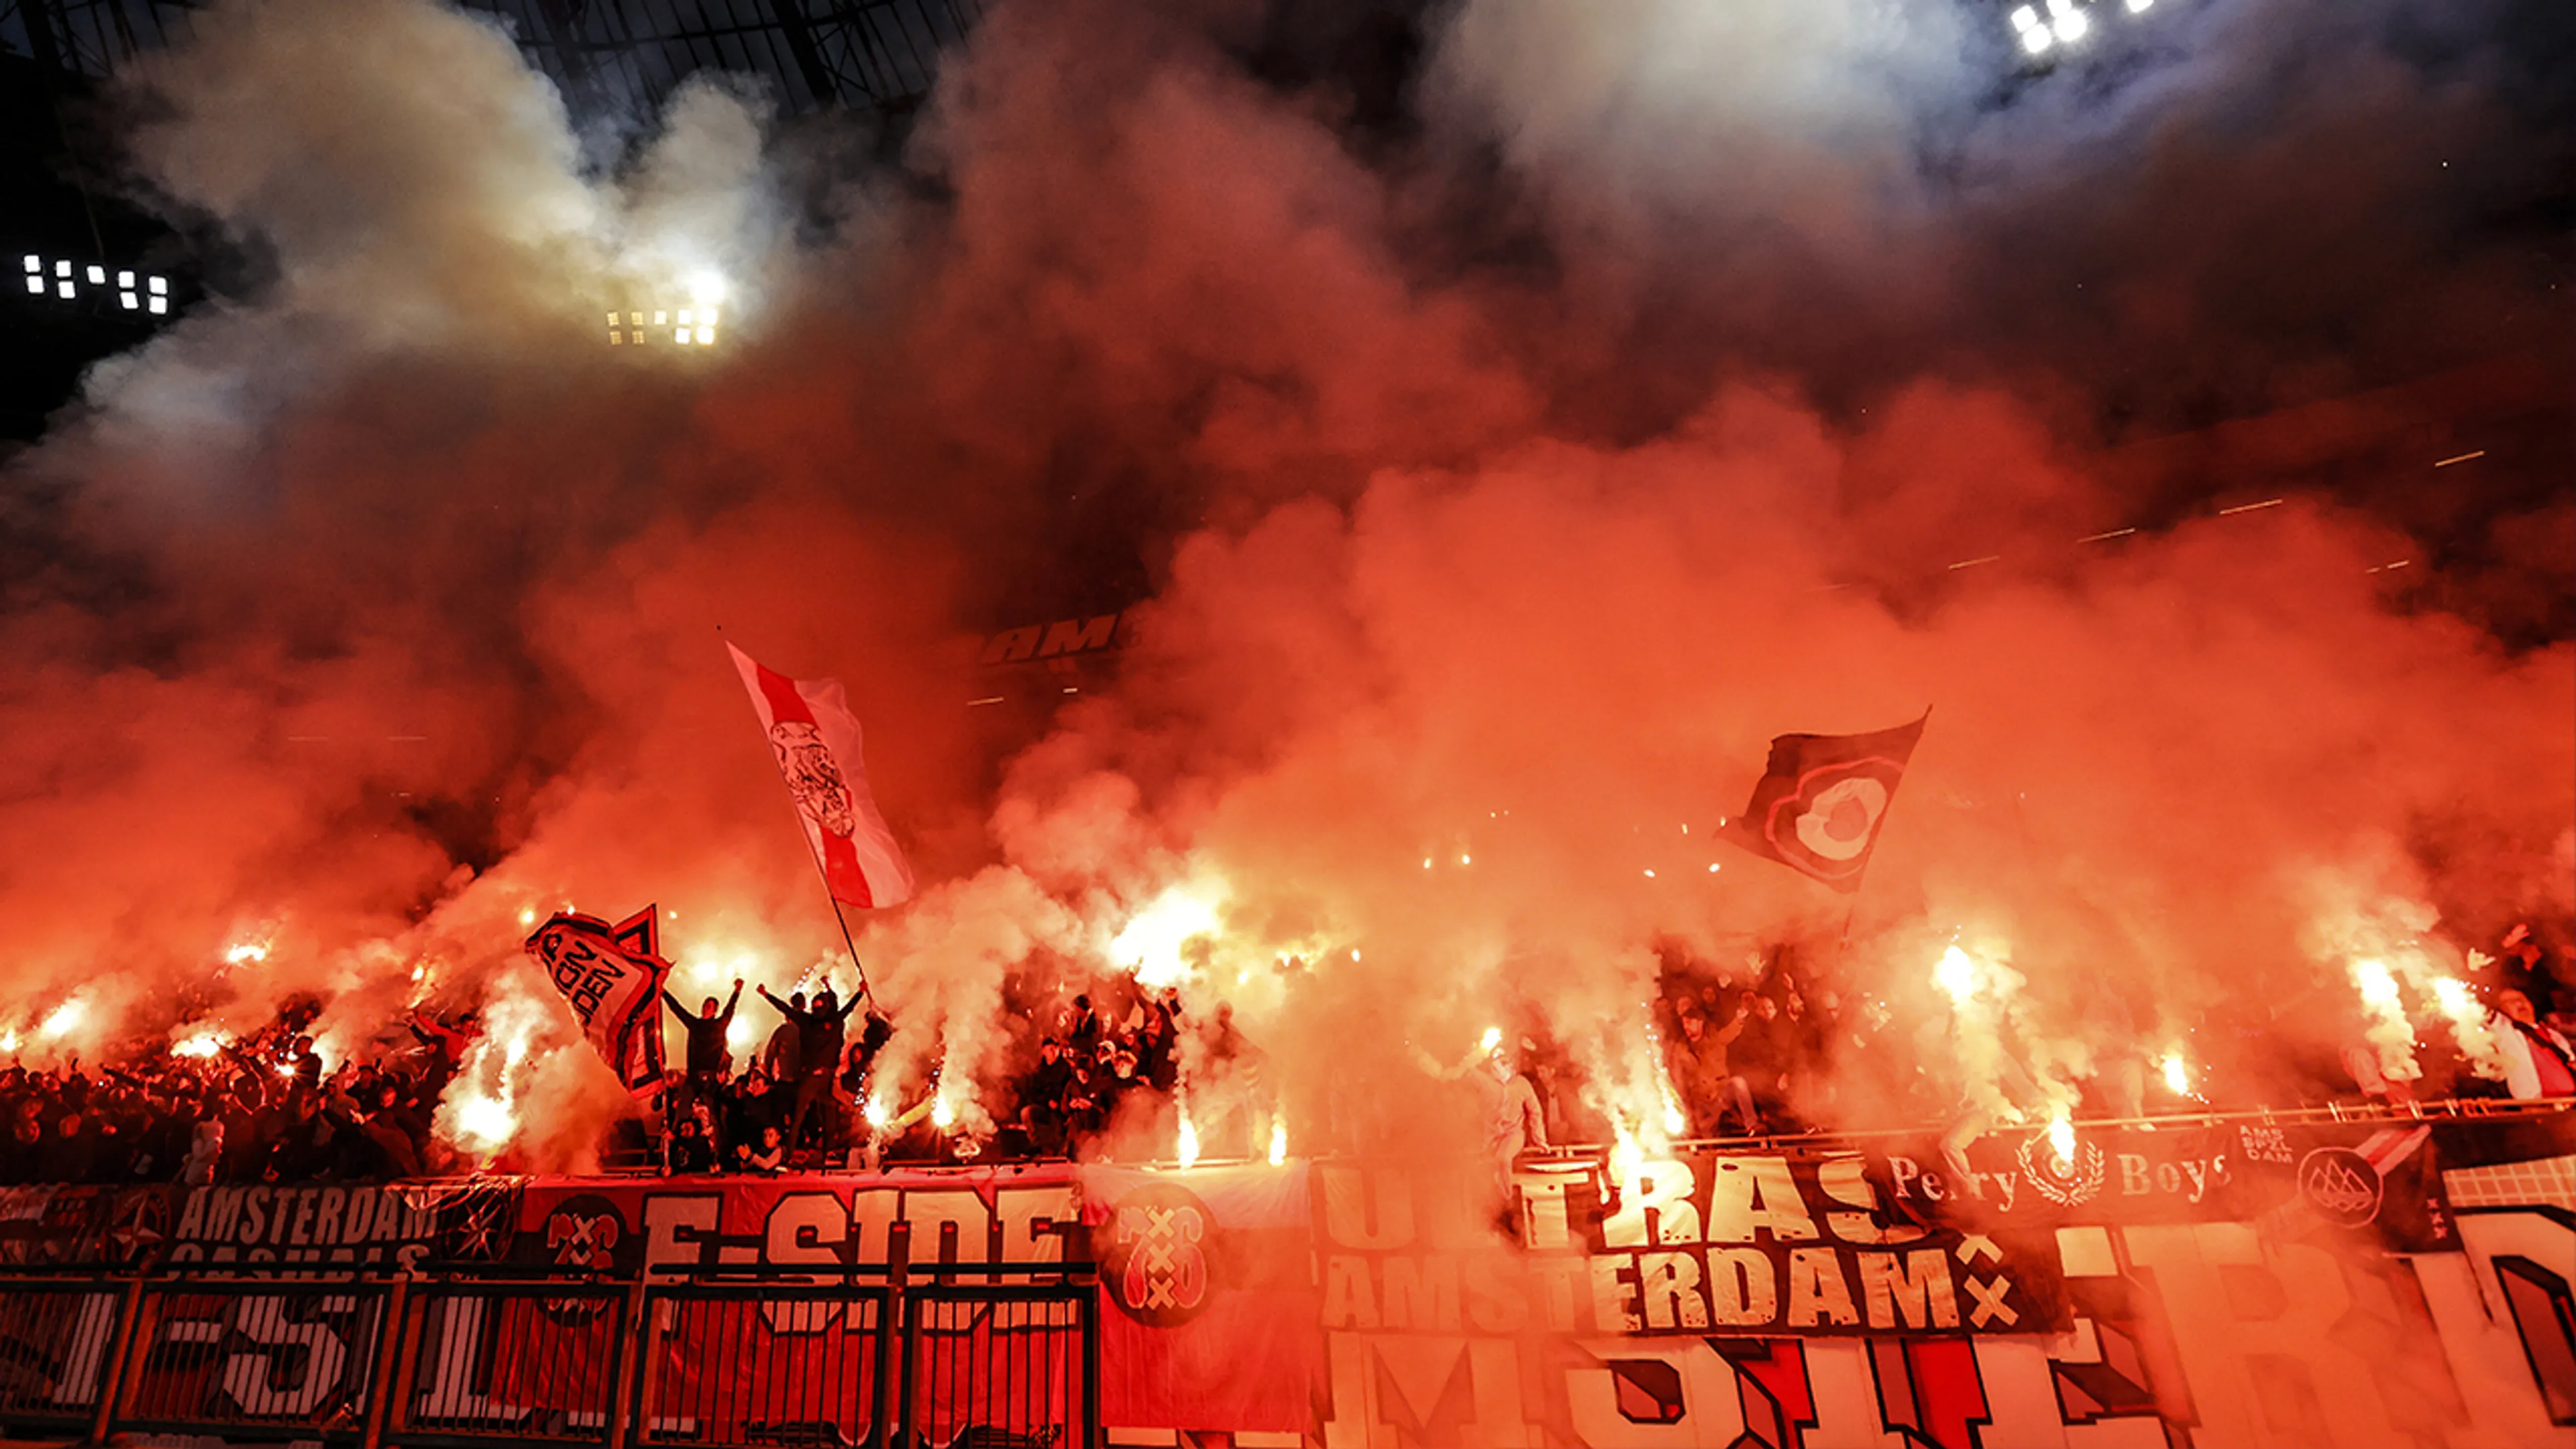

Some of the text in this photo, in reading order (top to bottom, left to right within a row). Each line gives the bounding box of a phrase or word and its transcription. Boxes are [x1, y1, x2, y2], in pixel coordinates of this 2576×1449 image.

[1887, 1155, 2017, 1212] Pery
[2117, 1151, 2233, 1201] Boys
[174, 1183, 448, 1246] AMSTERDAM
[1320, 1245, 1962, 1331] AMSTERDAM
